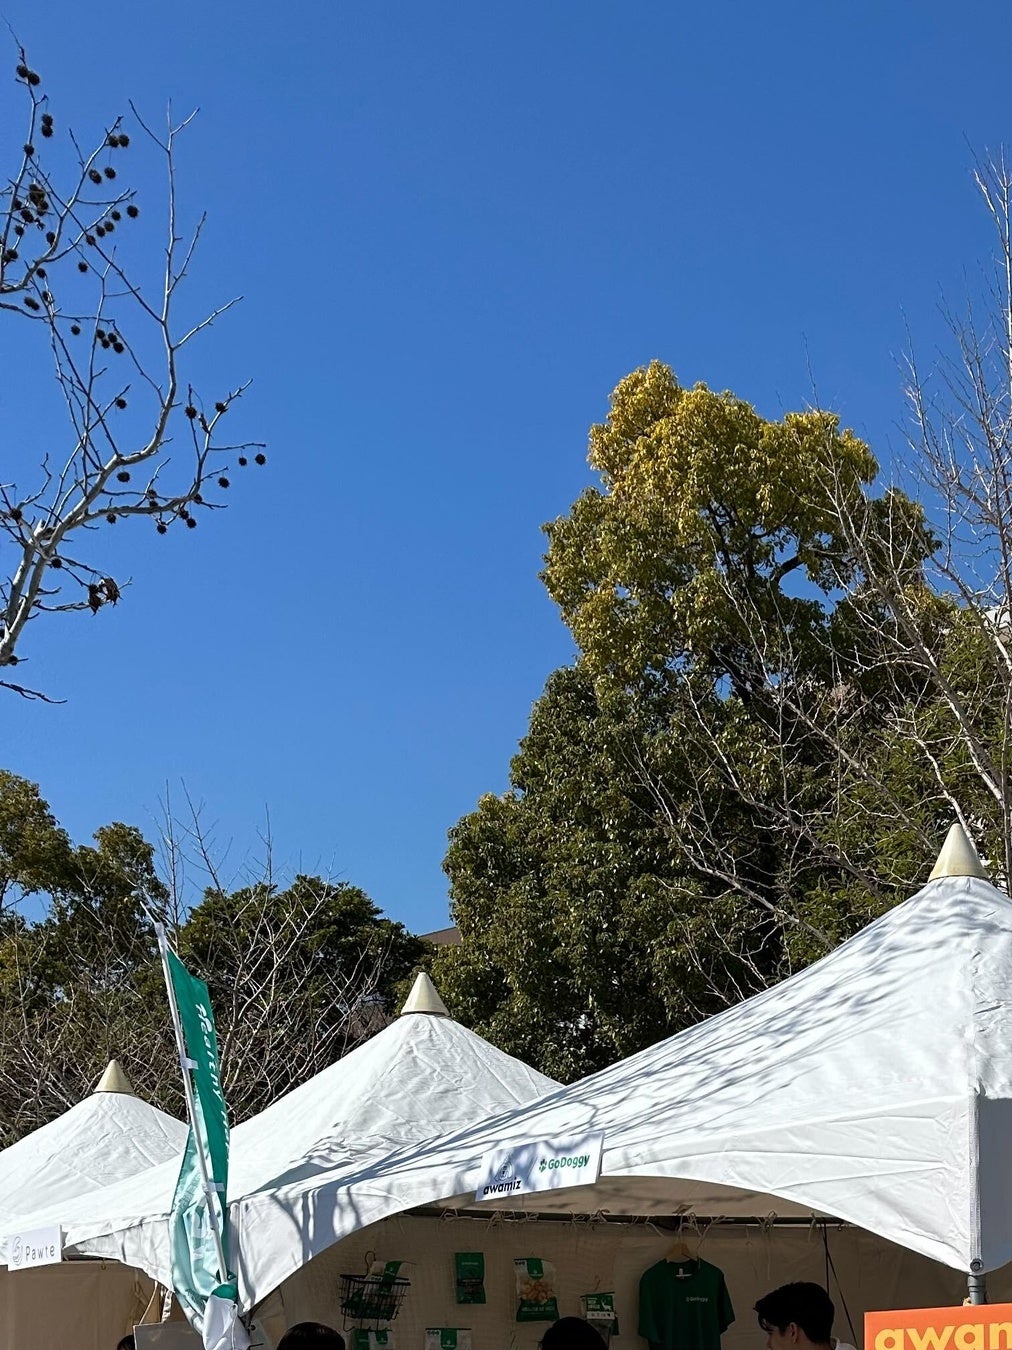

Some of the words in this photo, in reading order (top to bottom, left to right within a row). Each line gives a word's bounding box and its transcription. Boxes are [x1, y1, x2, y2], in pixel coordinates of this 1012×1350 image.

[548, 1154, 590, 1170] GoDoggy
[483, 1176, 522, 1195] awamiz
[25, 1245, 55, 1262] Pawte
